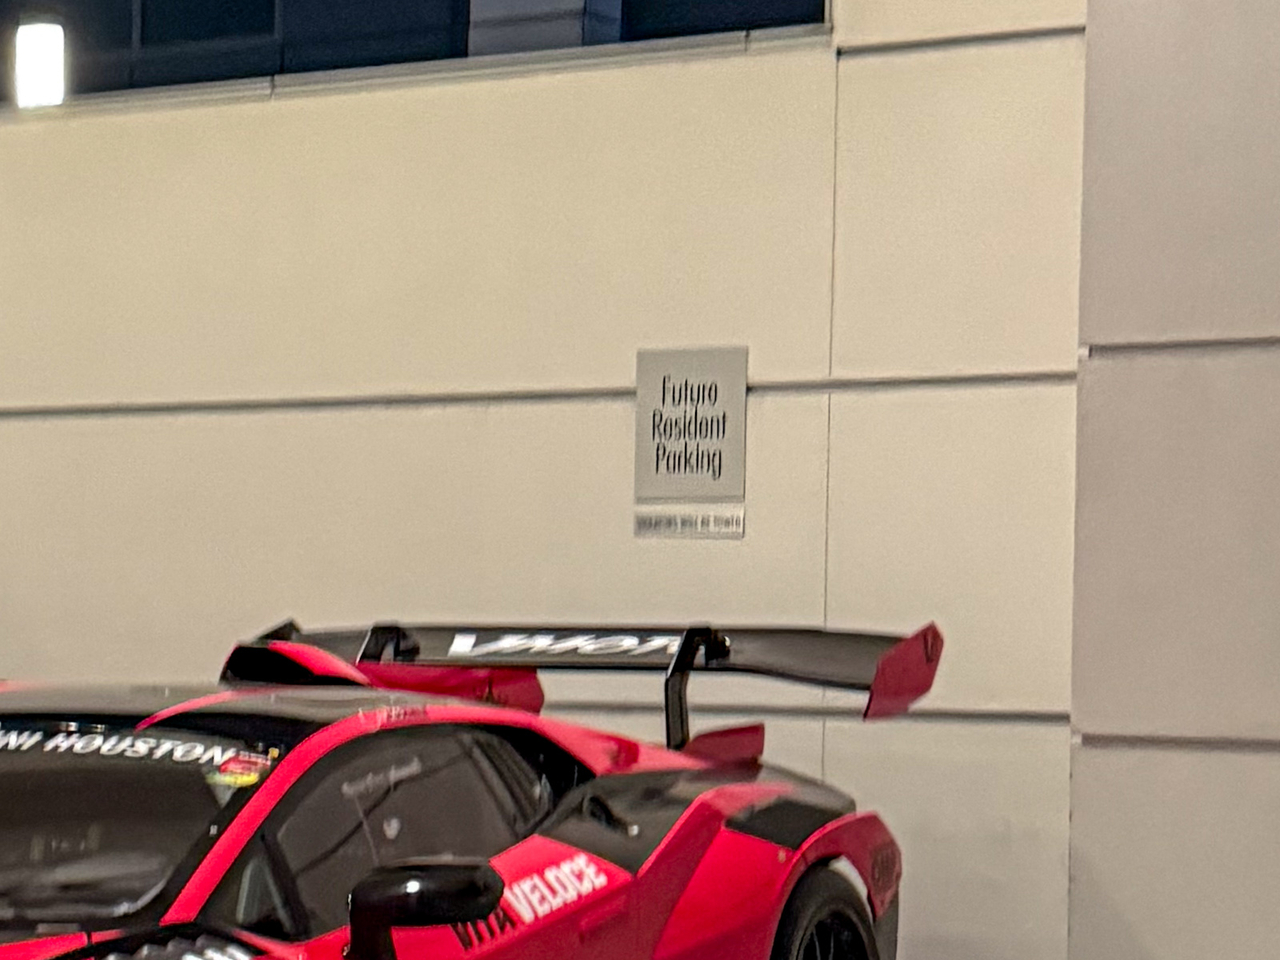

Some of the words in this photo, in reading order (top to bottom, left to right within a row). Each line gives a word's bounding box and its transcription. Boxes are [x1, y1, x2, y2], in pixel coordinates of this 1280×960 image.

[662, 374, 719, 407] Future
[652, 408, 726, 441] Resident
[656, 442, 722, 480] Parking
[43, 731, 237, 766] HOUSTON
[504, 852, 609, 924] VELOCE
